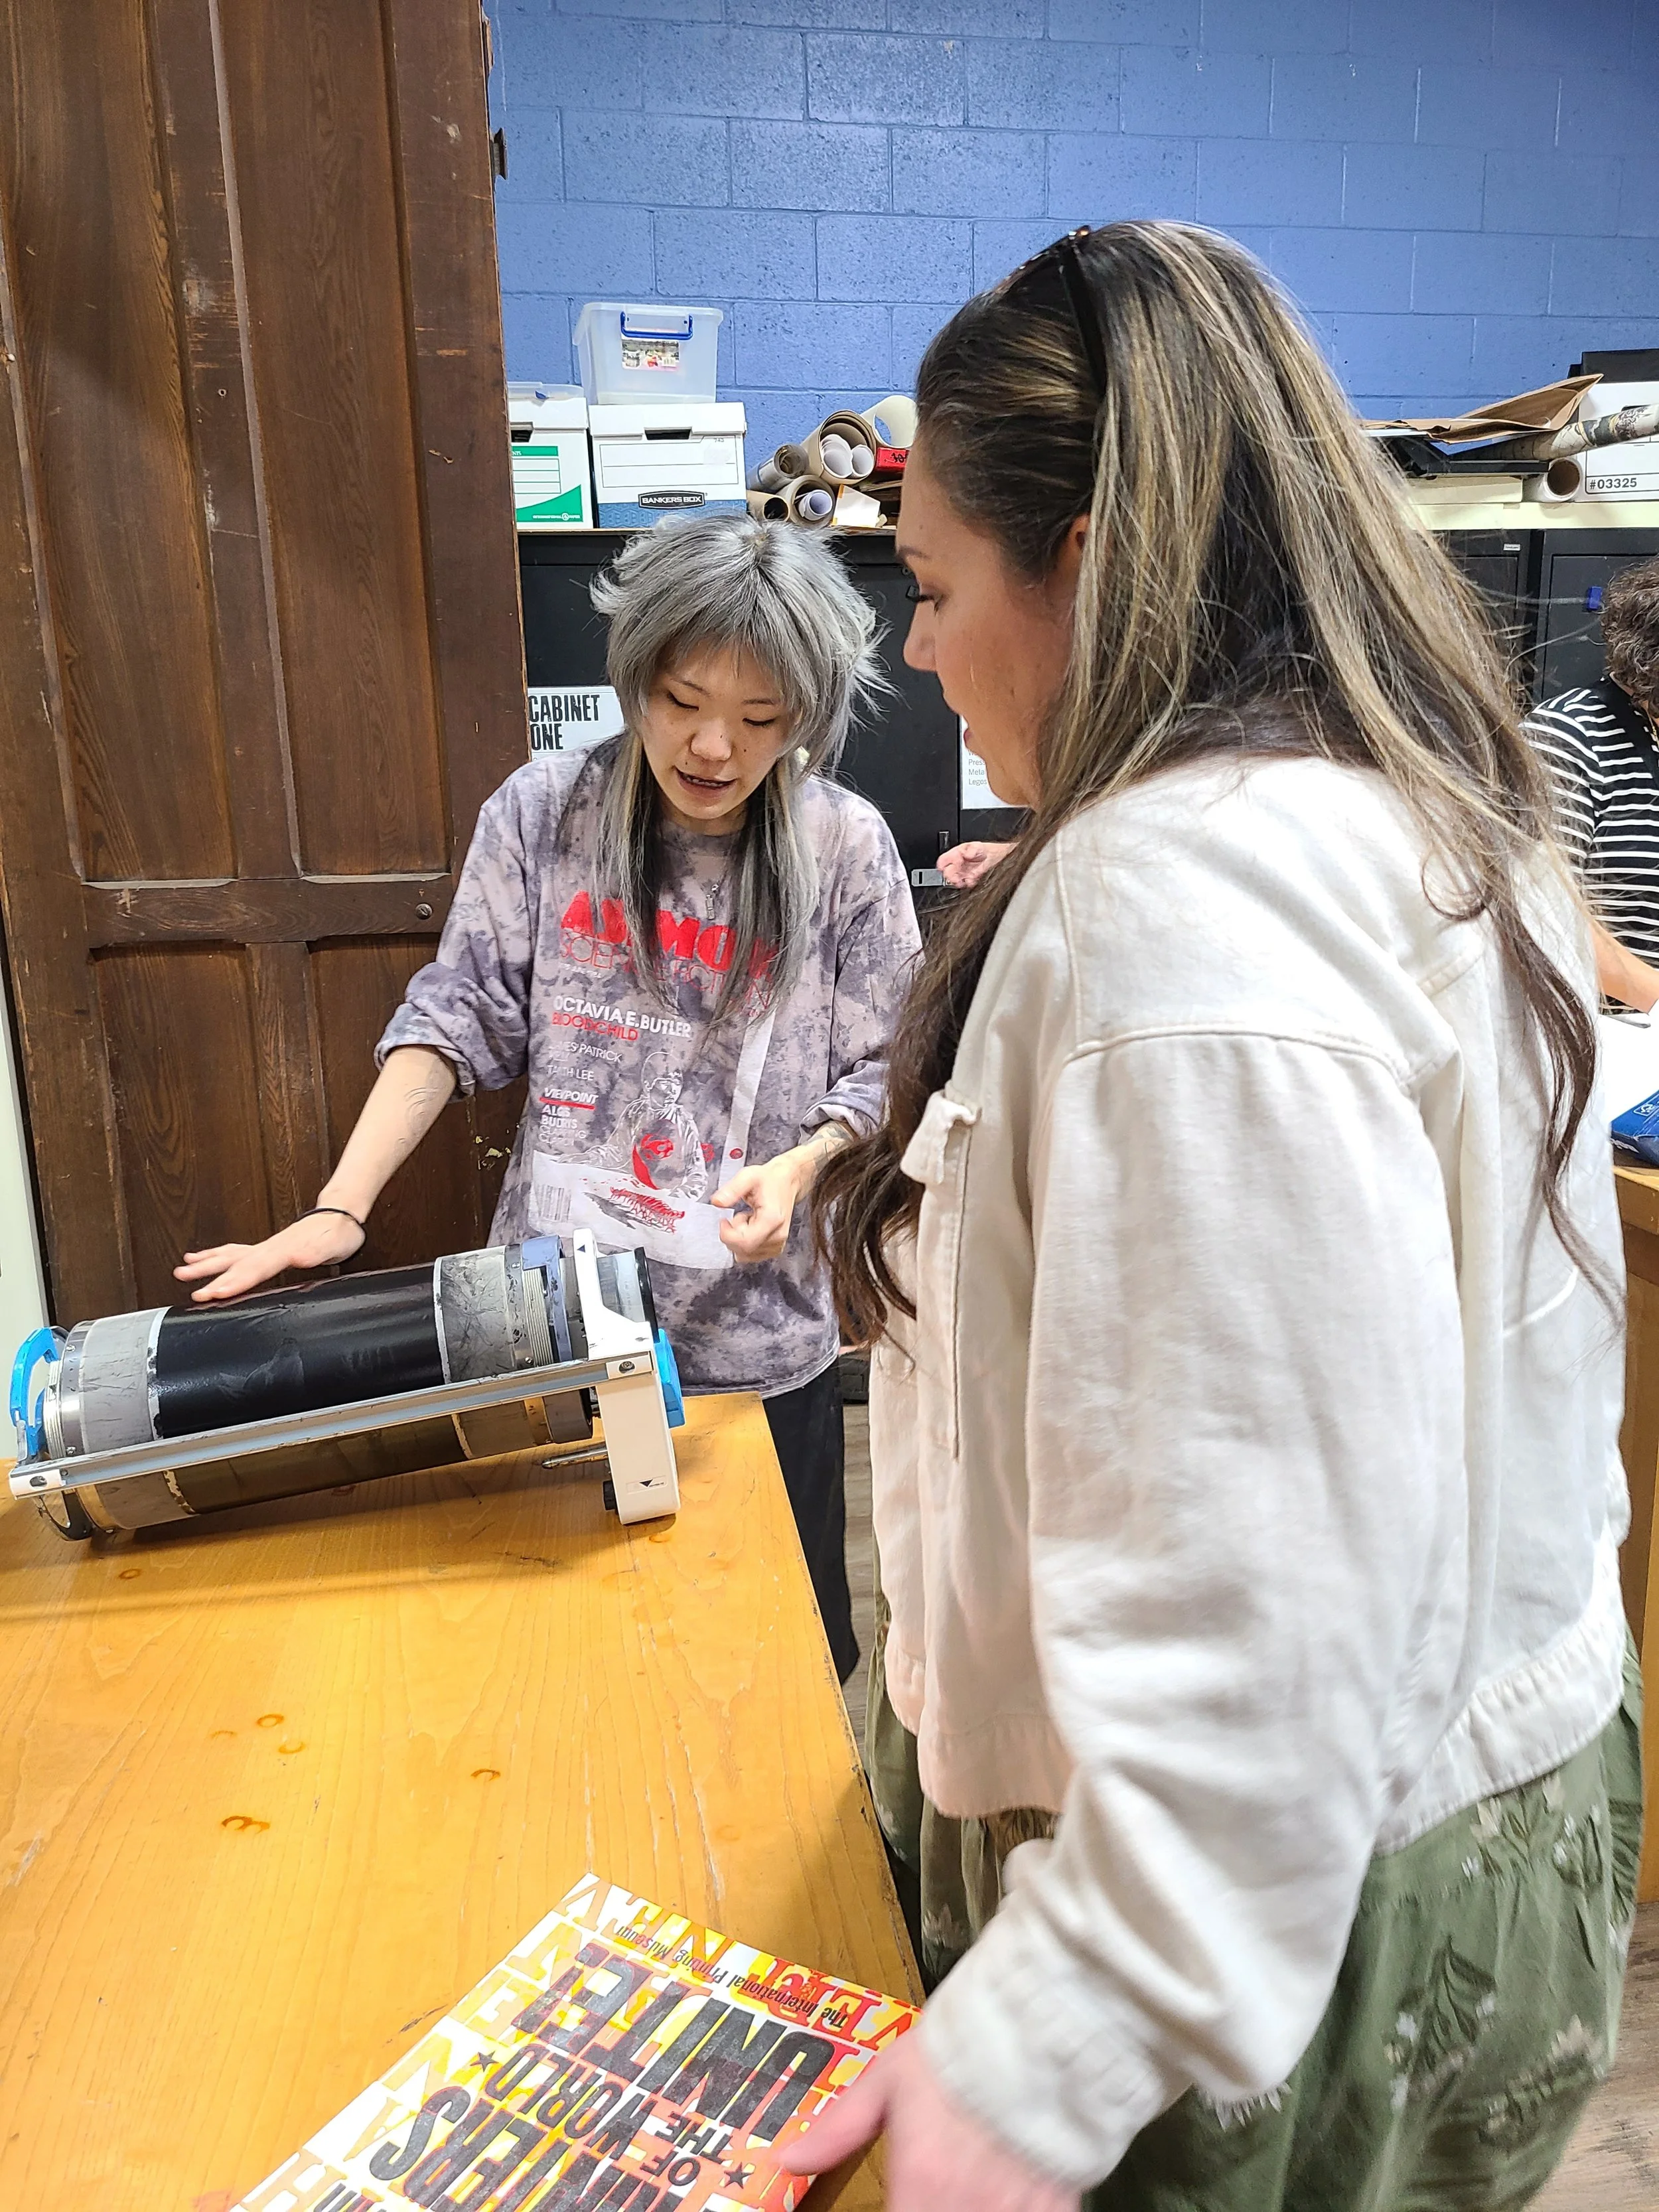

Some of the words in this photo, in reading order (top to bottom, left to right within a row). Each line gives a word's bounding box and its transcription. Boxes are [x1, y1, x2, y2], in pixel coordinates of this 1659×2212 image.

[1589, 477, 1637, 490] #03325
[528, 694, 600, 722] CABINET
[530, 723, 564, 751] ONE
[553, 995, 623, 1024] OCTAVIA
[640, 1014, 692, 1038] BUTLER
[579, 1043, 622, 1063] PATRICK
[575, 1069, 595, 1081] LEE
[616, 1925, 673, 1959] Museum
[675, 1949, 729, 1984] Printing
[726, 1974, 820, 2018] International
[820, 2006, 849, 2028] The
[510, 1942, 836, 2142] UNITE!
[484, 2043, 656, 2160] WORLD
[654, 2111, 733, 2163] THE
[640, 2150, 701, 2186] OF
